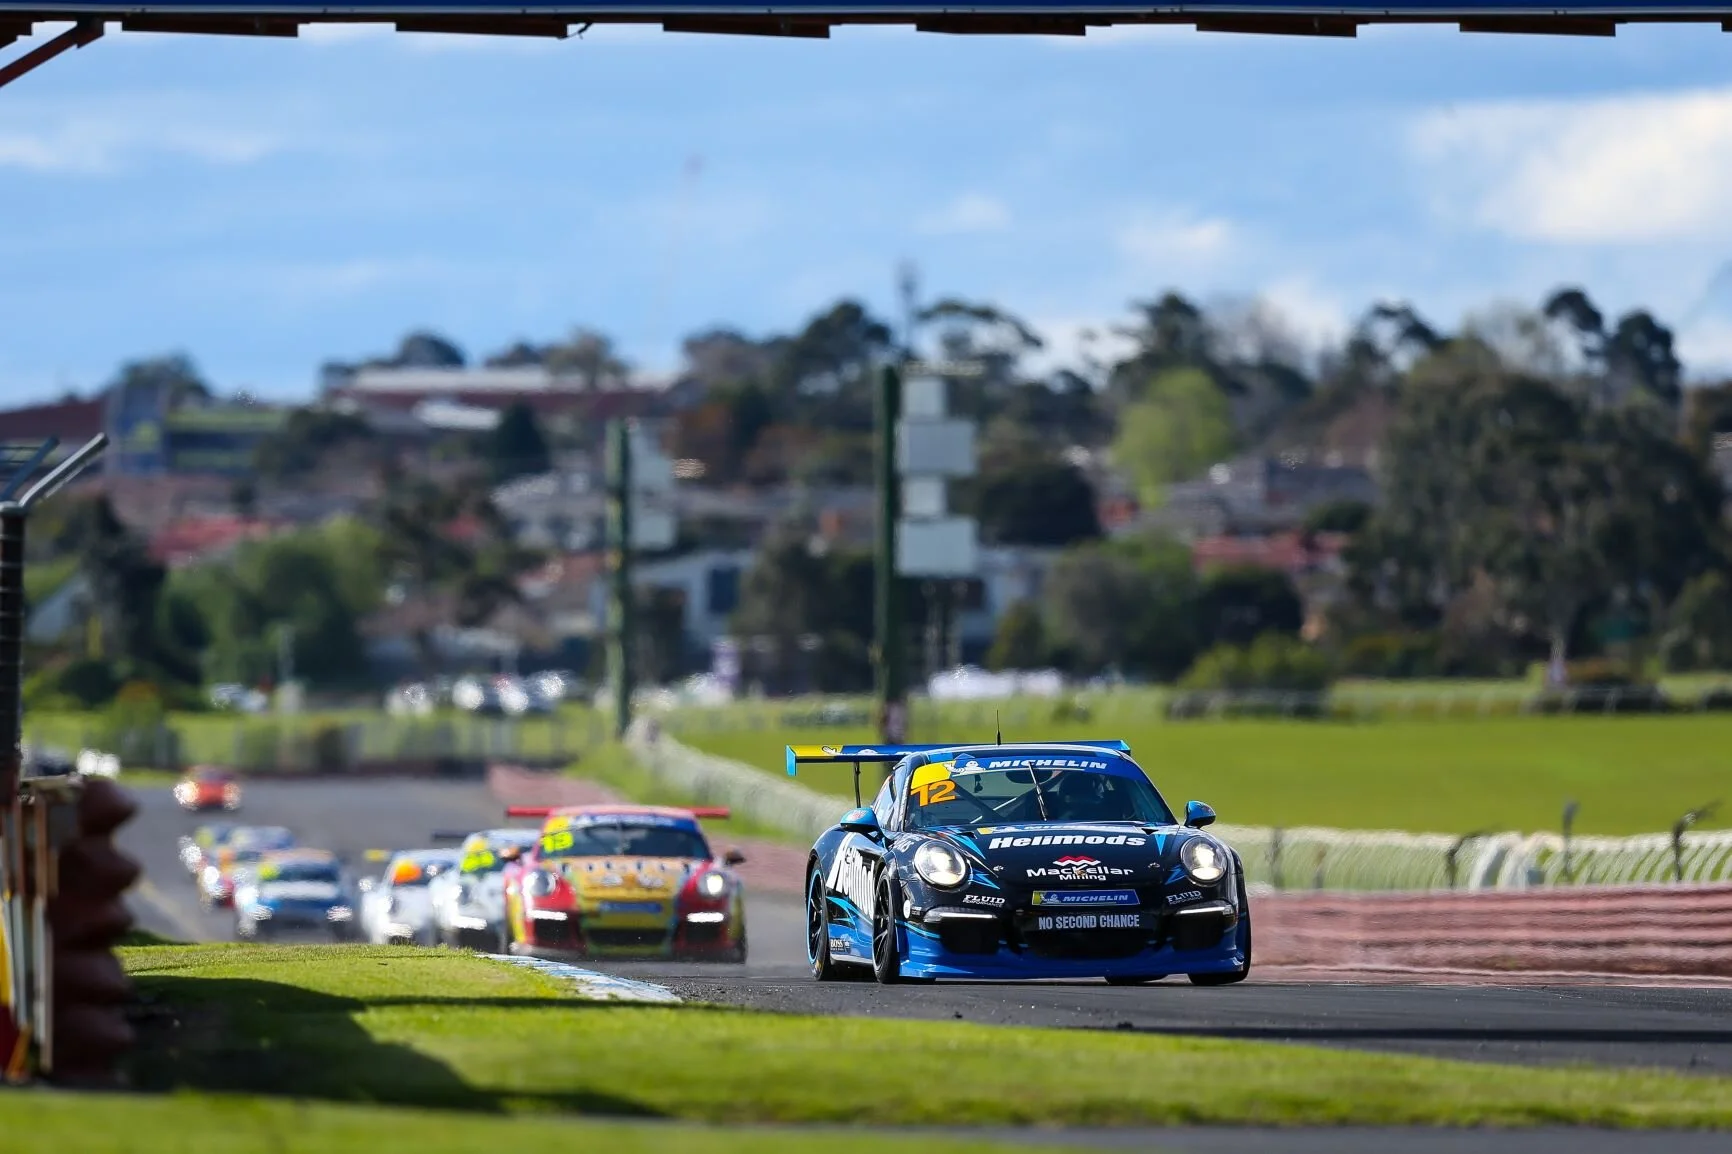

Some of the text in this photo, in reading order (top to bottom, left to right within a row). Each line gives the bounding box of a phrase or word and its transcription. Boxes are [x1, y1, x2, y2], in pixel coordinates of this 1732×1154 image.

[989, 759, 1108, 769] MICHELIN
[910, 779, 957, 807] 12
[988, 835, 1147, 850] Helimods
[965, 894, 1006, 904] FLUID
[1062, 894, 1129, 902] MICHELIN
[1166, 890, 1202, 903] FLUID
[1038, 914, 1140, 930] NO SECOND CHANCE
